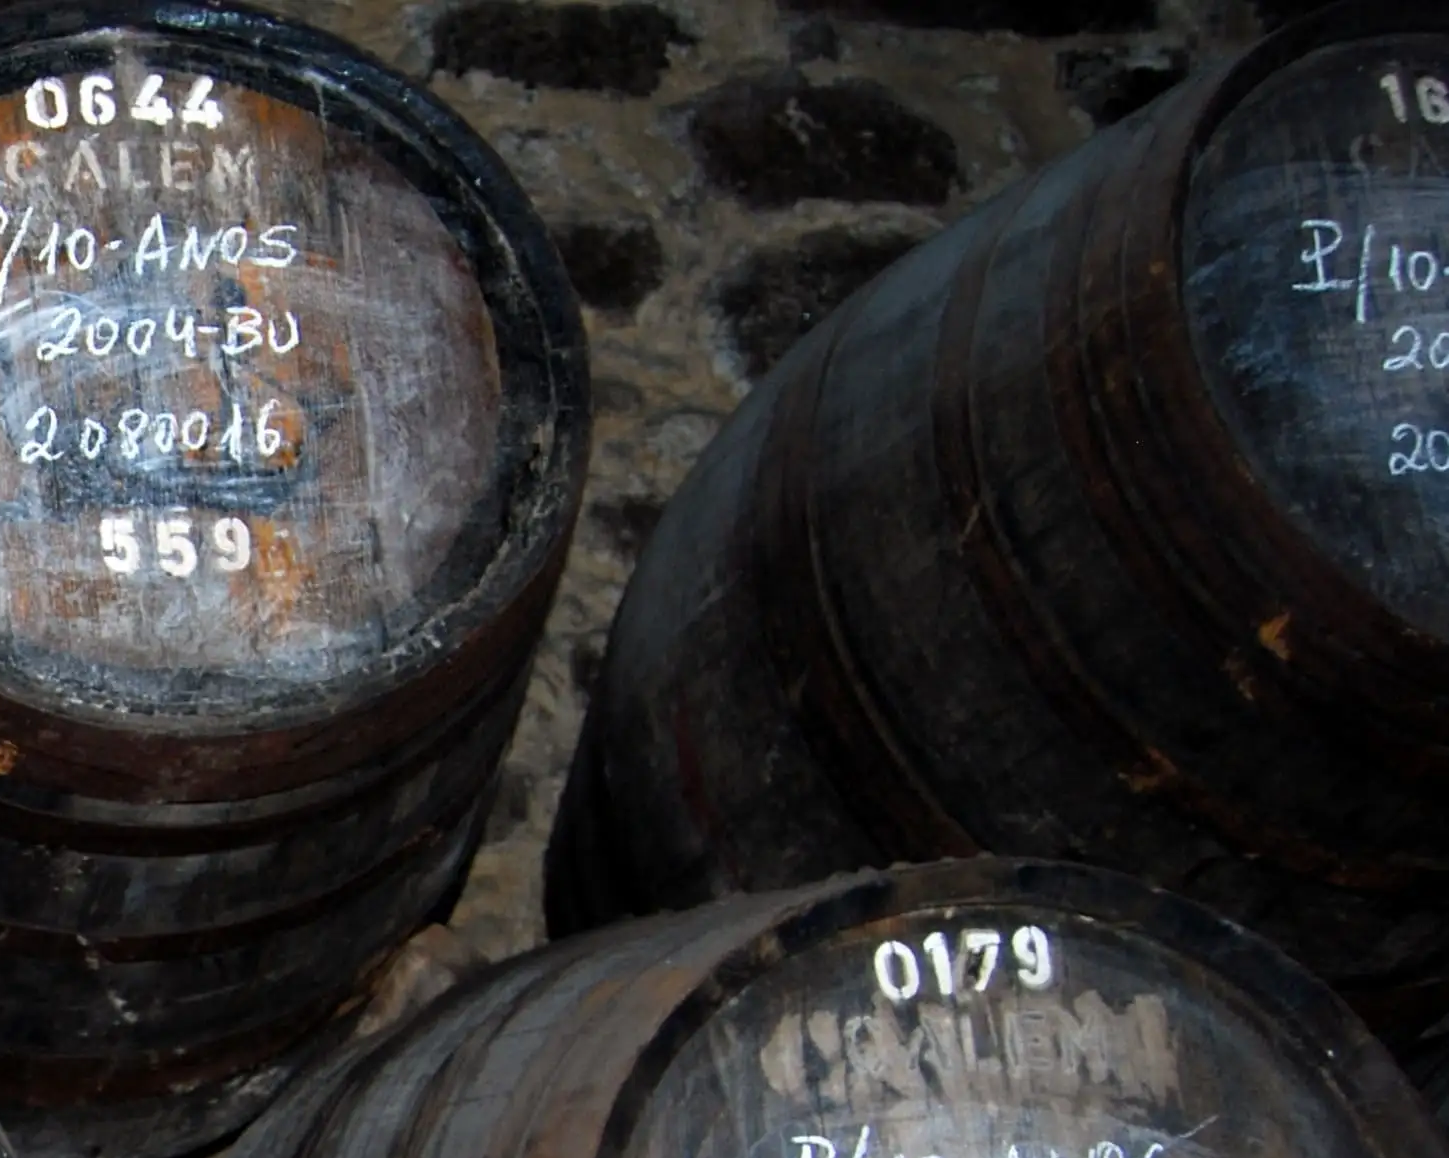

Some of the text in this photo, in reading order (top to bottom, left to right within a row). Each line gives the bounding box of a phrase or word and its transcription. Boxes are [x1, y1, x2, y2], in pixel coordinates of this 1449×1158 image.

[25, 75, 224, 128] 0644
[20, 399, 282, 465] 2080016
[100, 517, 252, 577] 559
[874, 926, 1053, 1000] 0179
